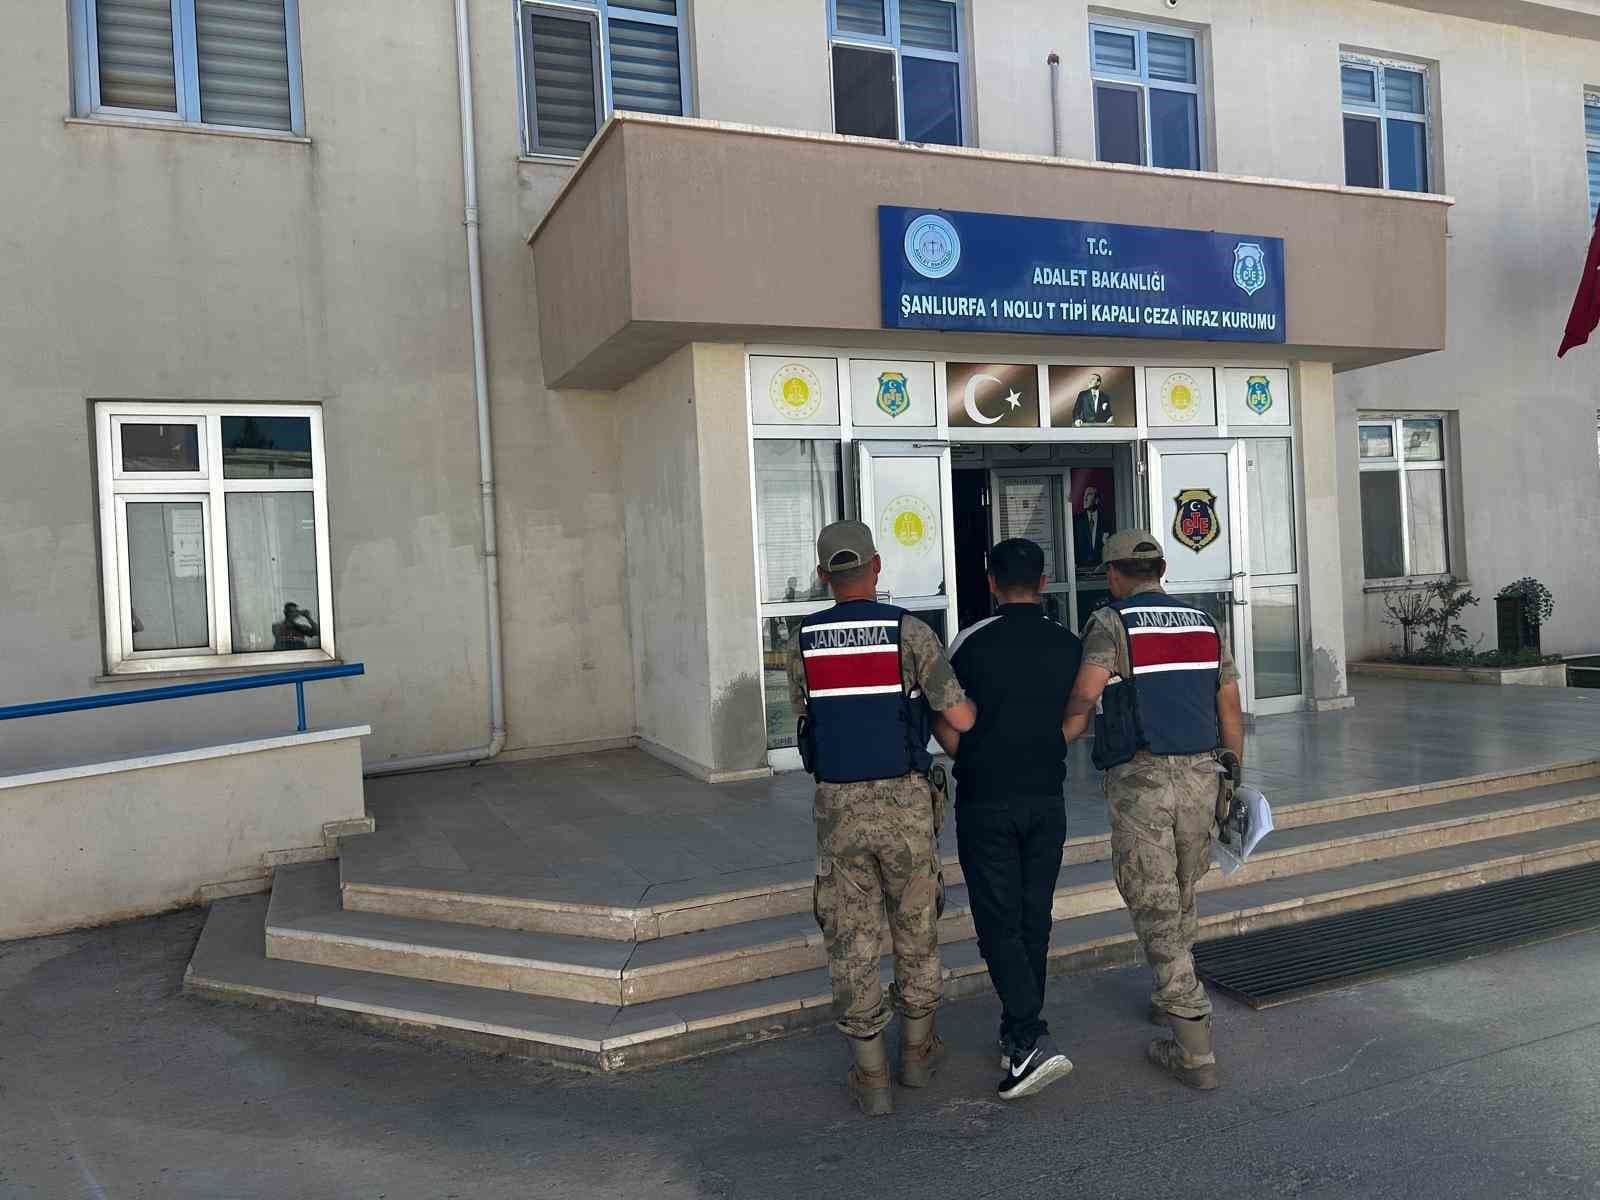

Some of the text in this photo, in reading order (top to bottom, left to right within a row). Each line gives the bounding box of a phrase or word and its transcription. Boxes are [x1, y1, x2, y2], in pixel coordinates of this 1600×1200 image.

[1087, 237, 1112, 256] T.C.
[1033, 267, 1165, 292] ADALET BAKANLIĞI
[901, 294, 1276, 331] ŞANLIURFA 1 NOLU T TİPİ KAPALI CEZA İNFAZ KURUMU
[1136, 611, 1207, 627] JANDARMA
[810, 626, 890, 649] JANDARMA
